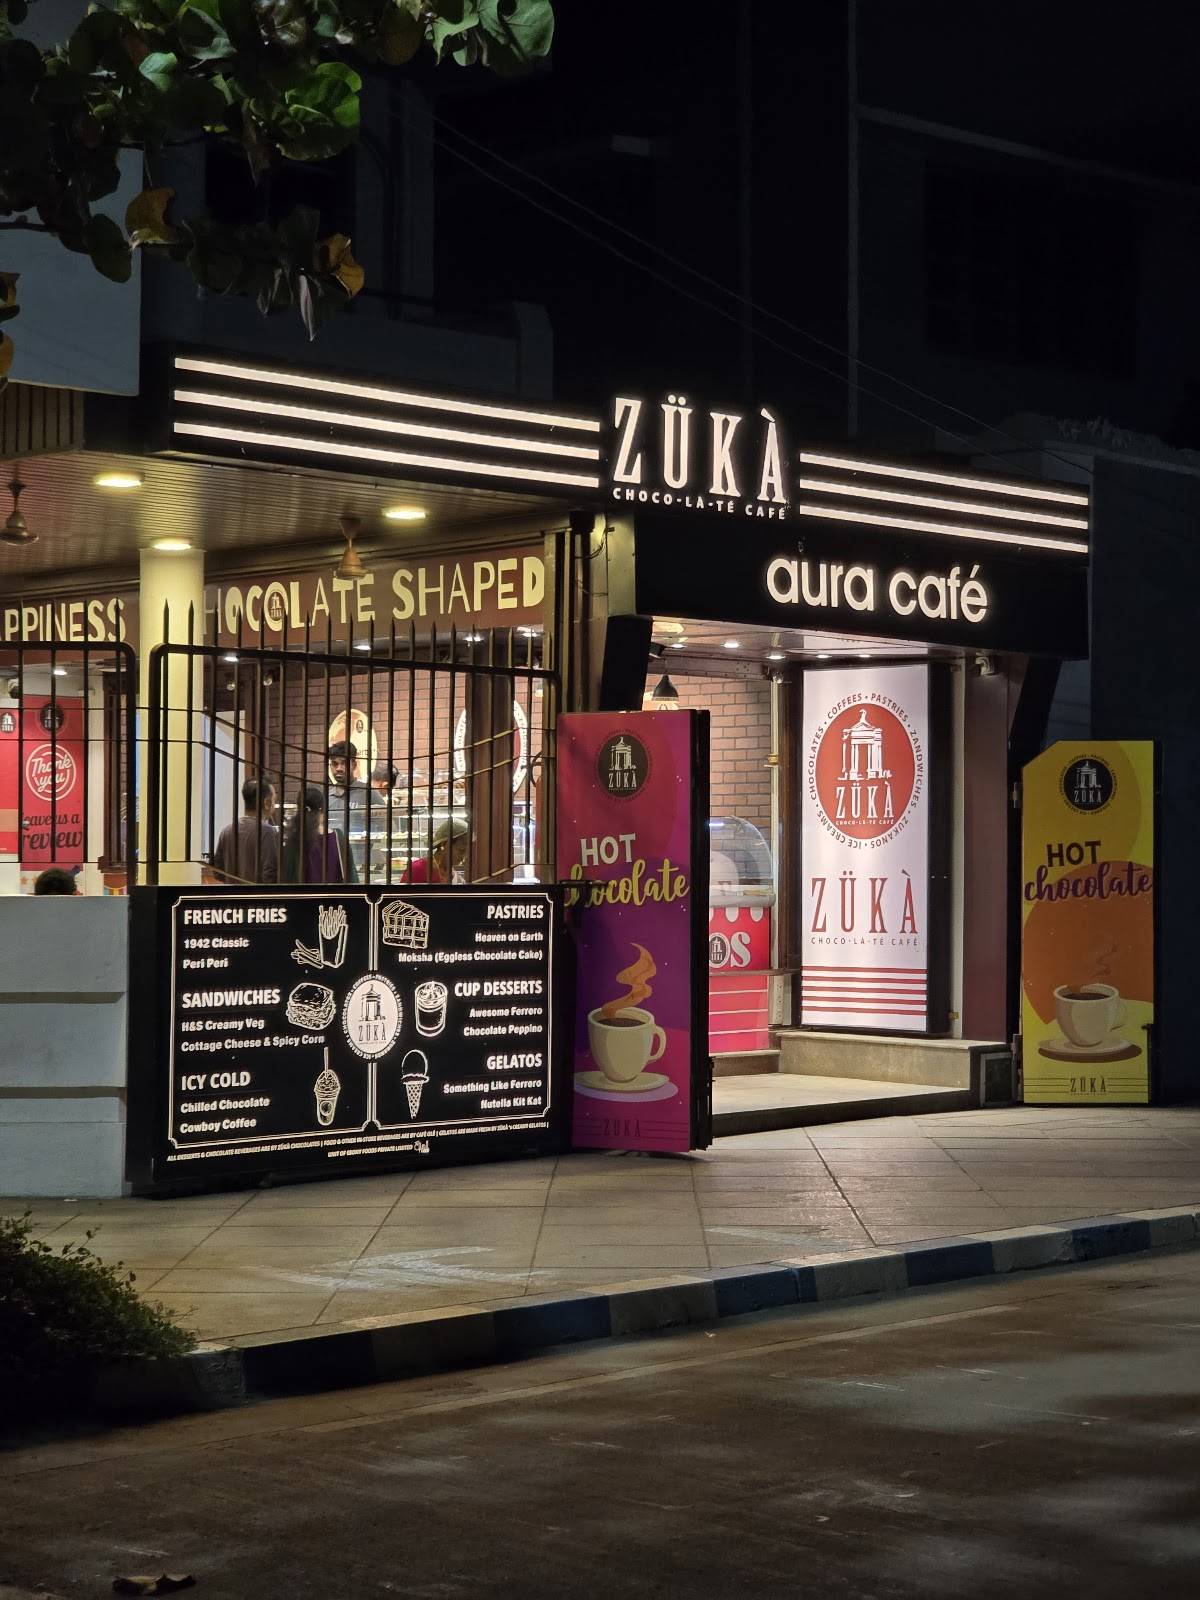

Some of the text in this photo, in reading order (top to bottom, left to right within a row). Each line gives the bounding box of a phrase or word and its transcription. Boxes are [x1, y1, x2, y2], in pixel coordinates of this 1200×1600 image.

[613, 394, 787, 504] ZÜKÀ
[745, 503, 787, 520] CAFÉ
[203, 556, 545, 634] HOCOLATE SHAPED
[766, 558, 988, 623] aura café
[0, 598, 126, 642] PPINESS
[827, 692, 863, 720] COFFEES
[870, 692, 909, 723] PASTRIES
[808, 725, 824, 801] CHOCOLATES
[909, 729, 924, 808] ZANDWICHES
[835, 780, 895, 819] ZÜKÀ
[816, 810, 846, 844] CREAMS
[581, 833, 636, 867] HOT
[847, 838, 862, 850] ICE
[1046, 840, 1102, 868] HOT
[564, 858, 690, 908] hocolate
[1024, 861, 1153, 901] chocolate
[811, 868, 919, 935] ZÜKÀ
[183, 907, 288, 925] FRENCH FRIES
[487, 904, 544, 919] PASTRIES
[184, 937, 250, 949] 1942 Classic
[475, 931, 544, 943] Heaven on Earth
[891, 937, 918, 946] CAFÉ
[182, 957, 229, 969] Peri Peri
[398, 949, 543, 964] Moksha (Eggless Chocolate Cake)
[454, 980, 543, 997] CUP DESSERTS
[181, 988, 281, 1009] SANDWICHES
[469, 1006, 543, 1018] Awesome Ferrero
[181, 1018, 265, 1032] H&S Creamy Veg
[463, 1023, 543, 1037] Chocolate Peppino
[181, 1034, 325, 1052] Cottage Cheese & Spicy Corn
[486, 1053, 543, 1070] GELATOS
[181, 1071, 251, 1091] ICY COLD
[443, 1079, 543, 1094] Something Like Ferrero
[180, 1097, 270, 1114] Chilled Chocolate
[480, 1096, 542, 1109] Nutella Kit Kat
[180, 1117, 257, 1133] Cowboy Coffee
